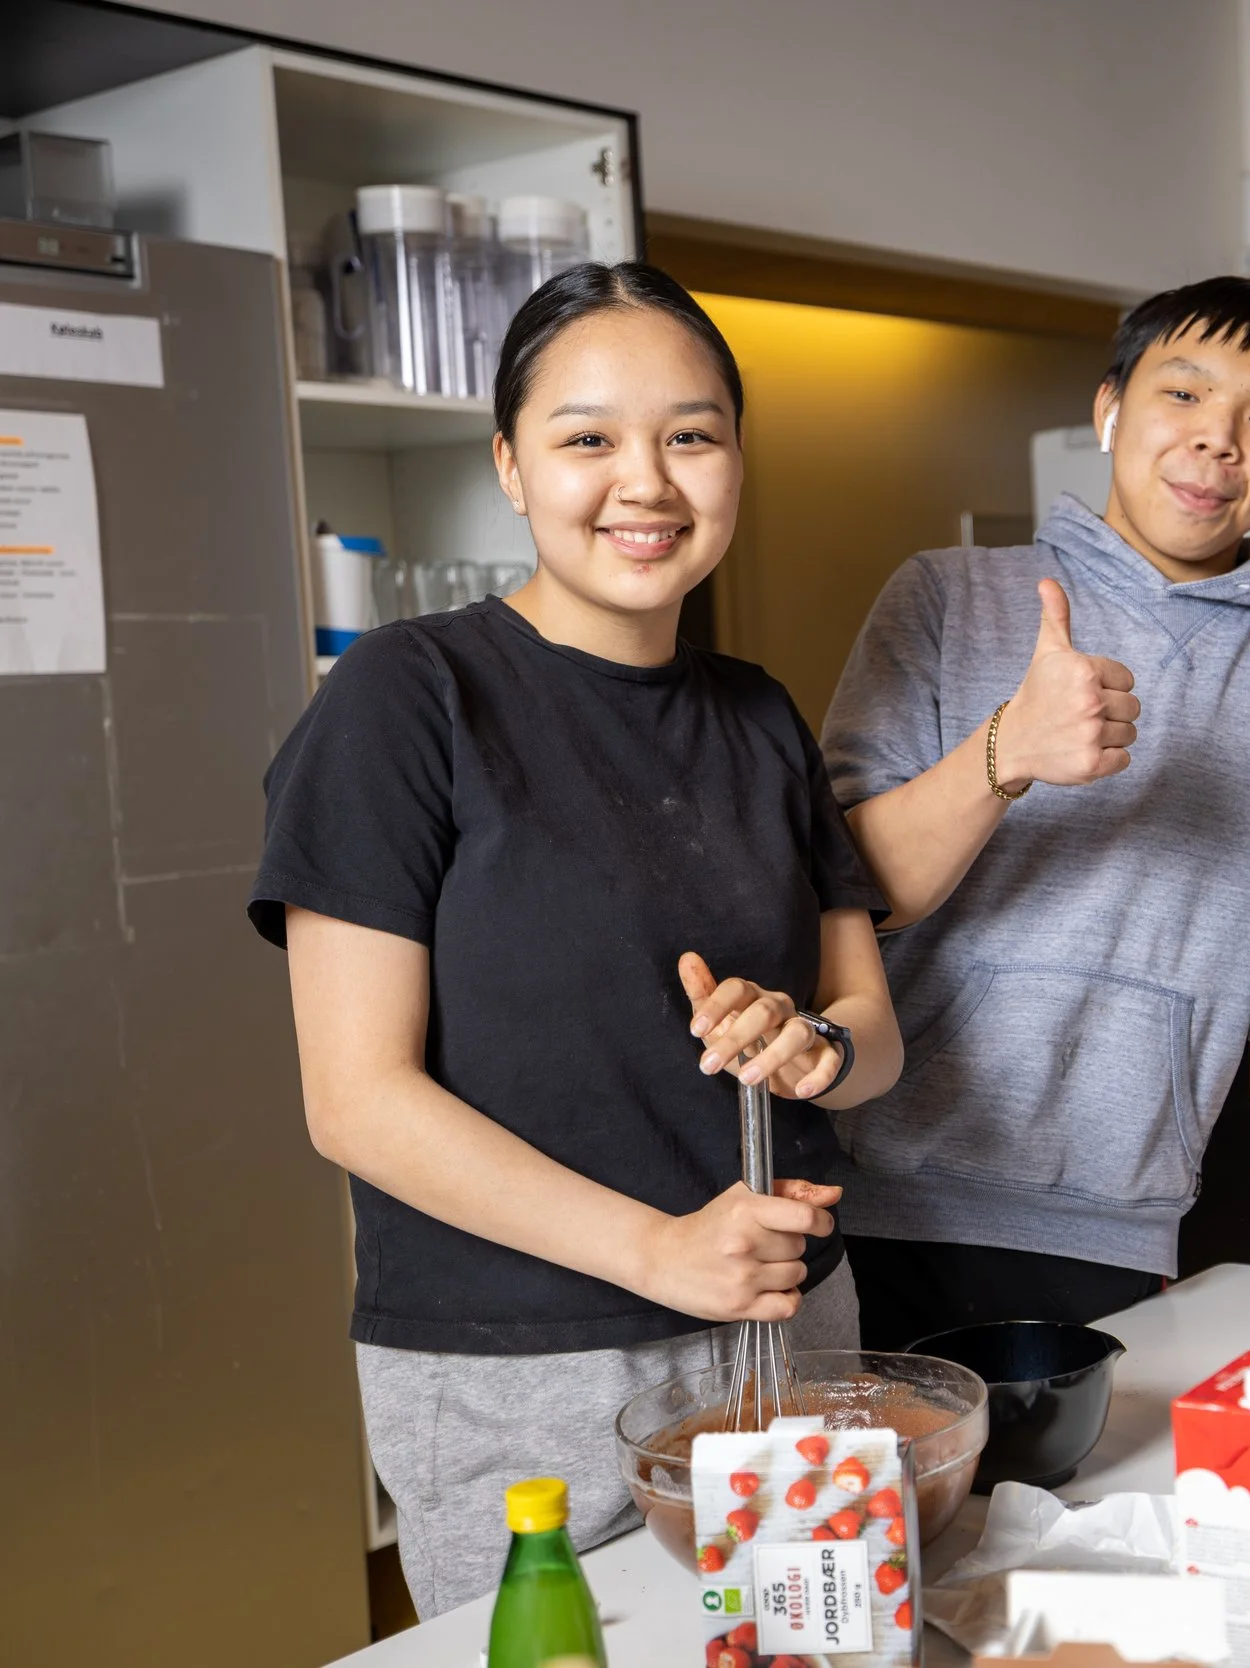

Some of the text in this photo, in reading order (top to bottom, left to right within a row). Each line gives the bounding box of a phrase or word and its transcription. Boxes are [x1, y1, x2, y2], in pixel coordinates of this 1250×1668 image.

[772, 1582, 787, 1616] 365
[787, 1567, 804, 1631] ØKOLOGI
[821, 1548, 840, 1645] JORDBÆR
